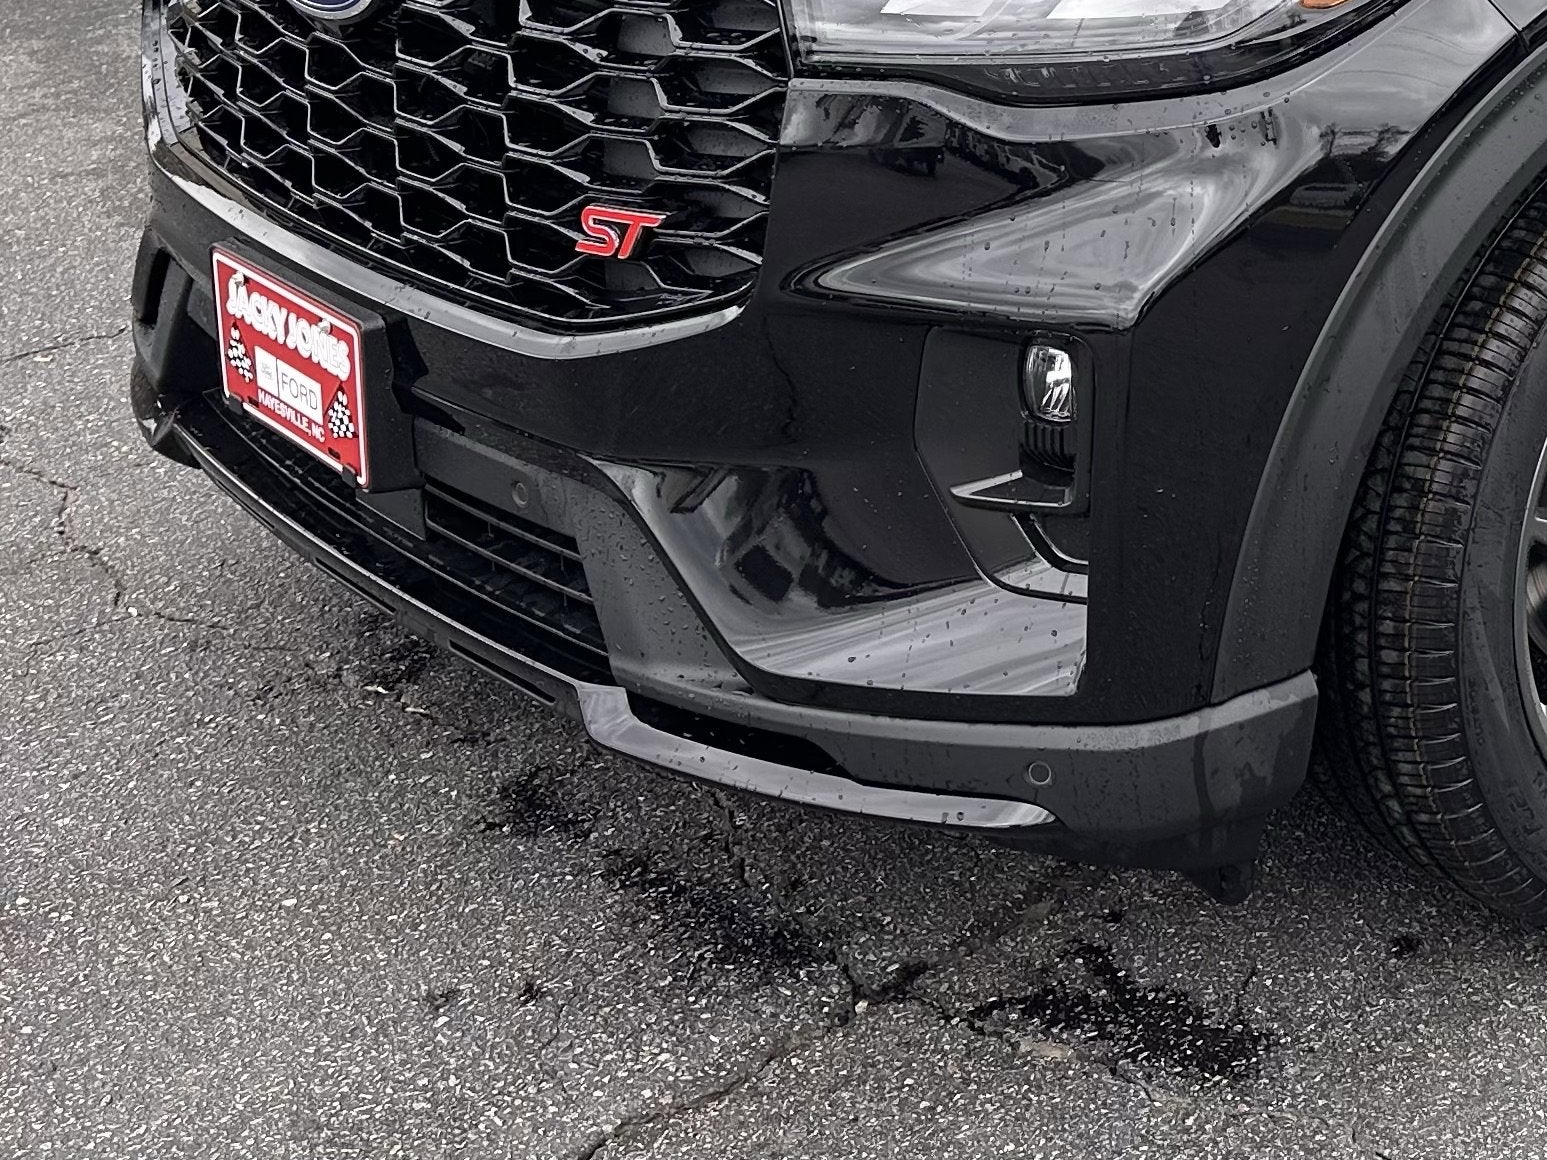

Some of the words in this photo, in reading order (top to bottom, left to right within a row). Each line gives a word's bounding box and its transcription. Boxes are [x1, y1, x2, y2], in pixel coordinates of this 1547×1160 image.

[575, 205, 666, 259] ST
[226, 271, 288, 344] JACKY
[286, 313, 350, 381] JONES
[281, 372, 317, 410] FORD
[311, 422, 326, 443] NC
